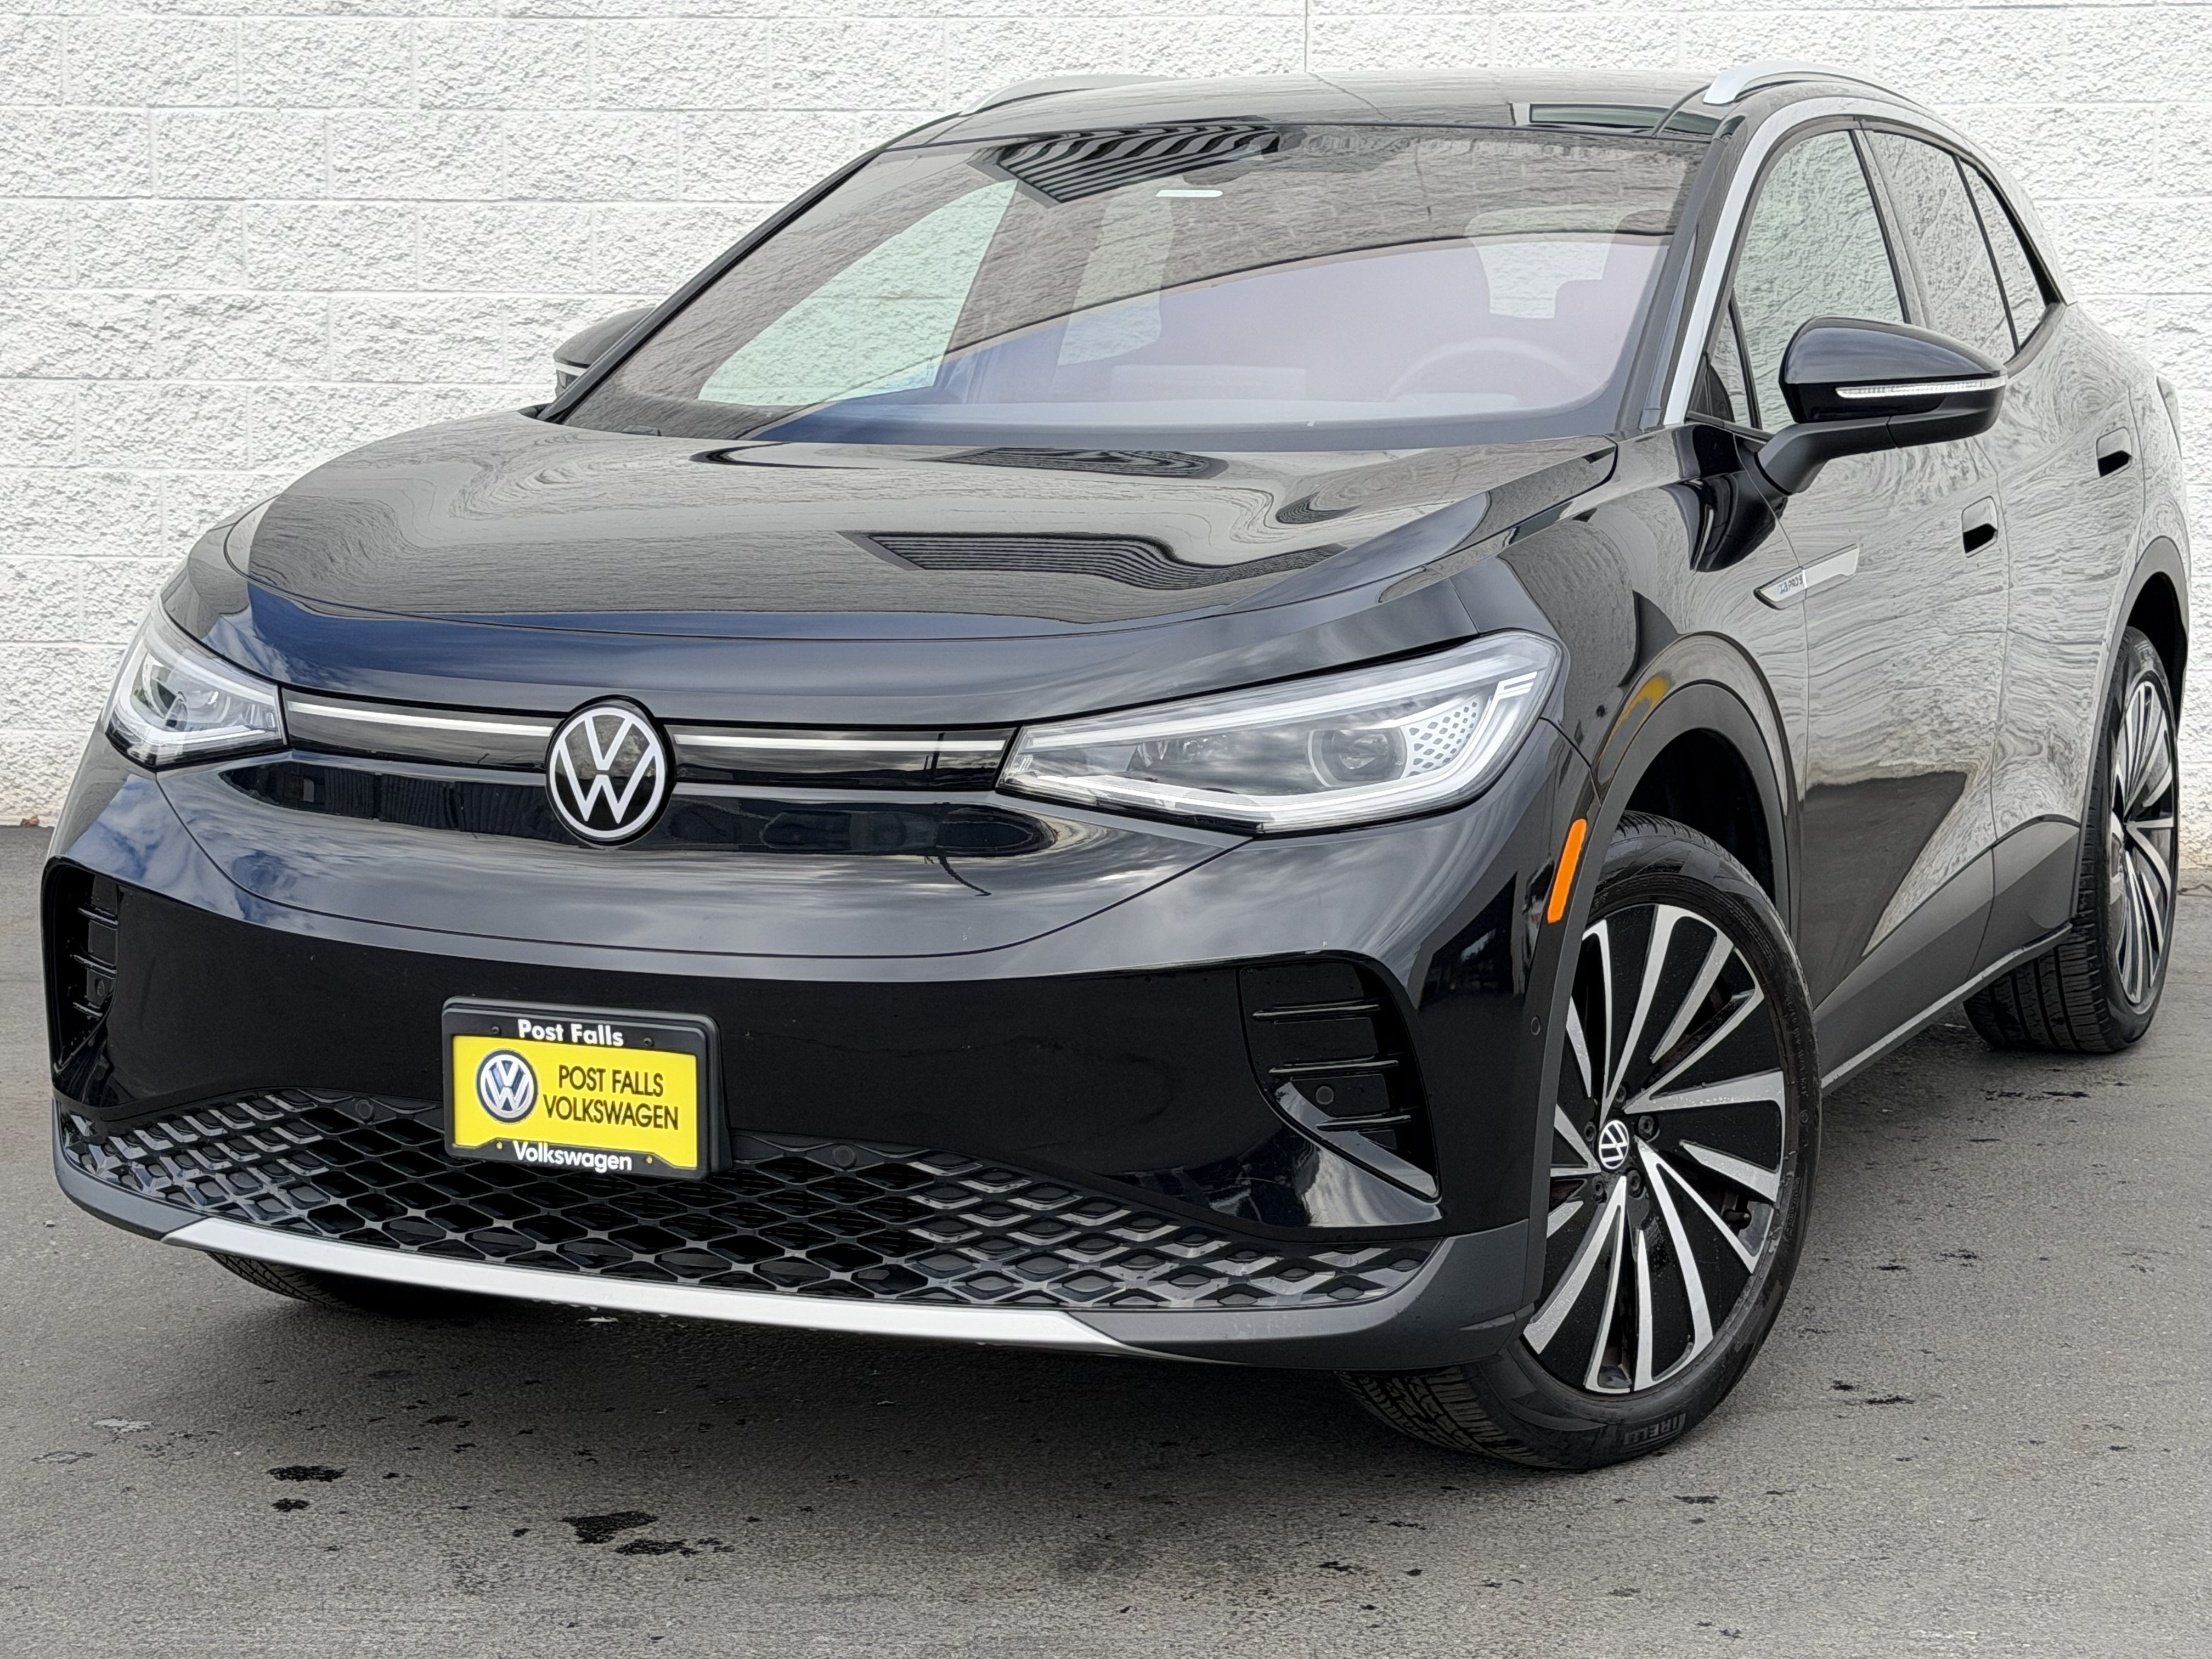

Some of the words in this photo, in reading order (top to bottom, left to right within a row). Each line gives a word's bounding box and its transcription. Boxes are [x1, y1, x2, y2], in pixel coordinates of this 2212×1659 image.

[517, 1019, 564, 1042] Post
[571, 1024, 624, 1047] Falls
[558, 1064, 606, 1092] POST
[612, 1069, 664, 1097] FALLS
[543, 1094, 679, 1131] VOLKSWAGEN
[512, 1141, 633, 1173] Volkswagen
